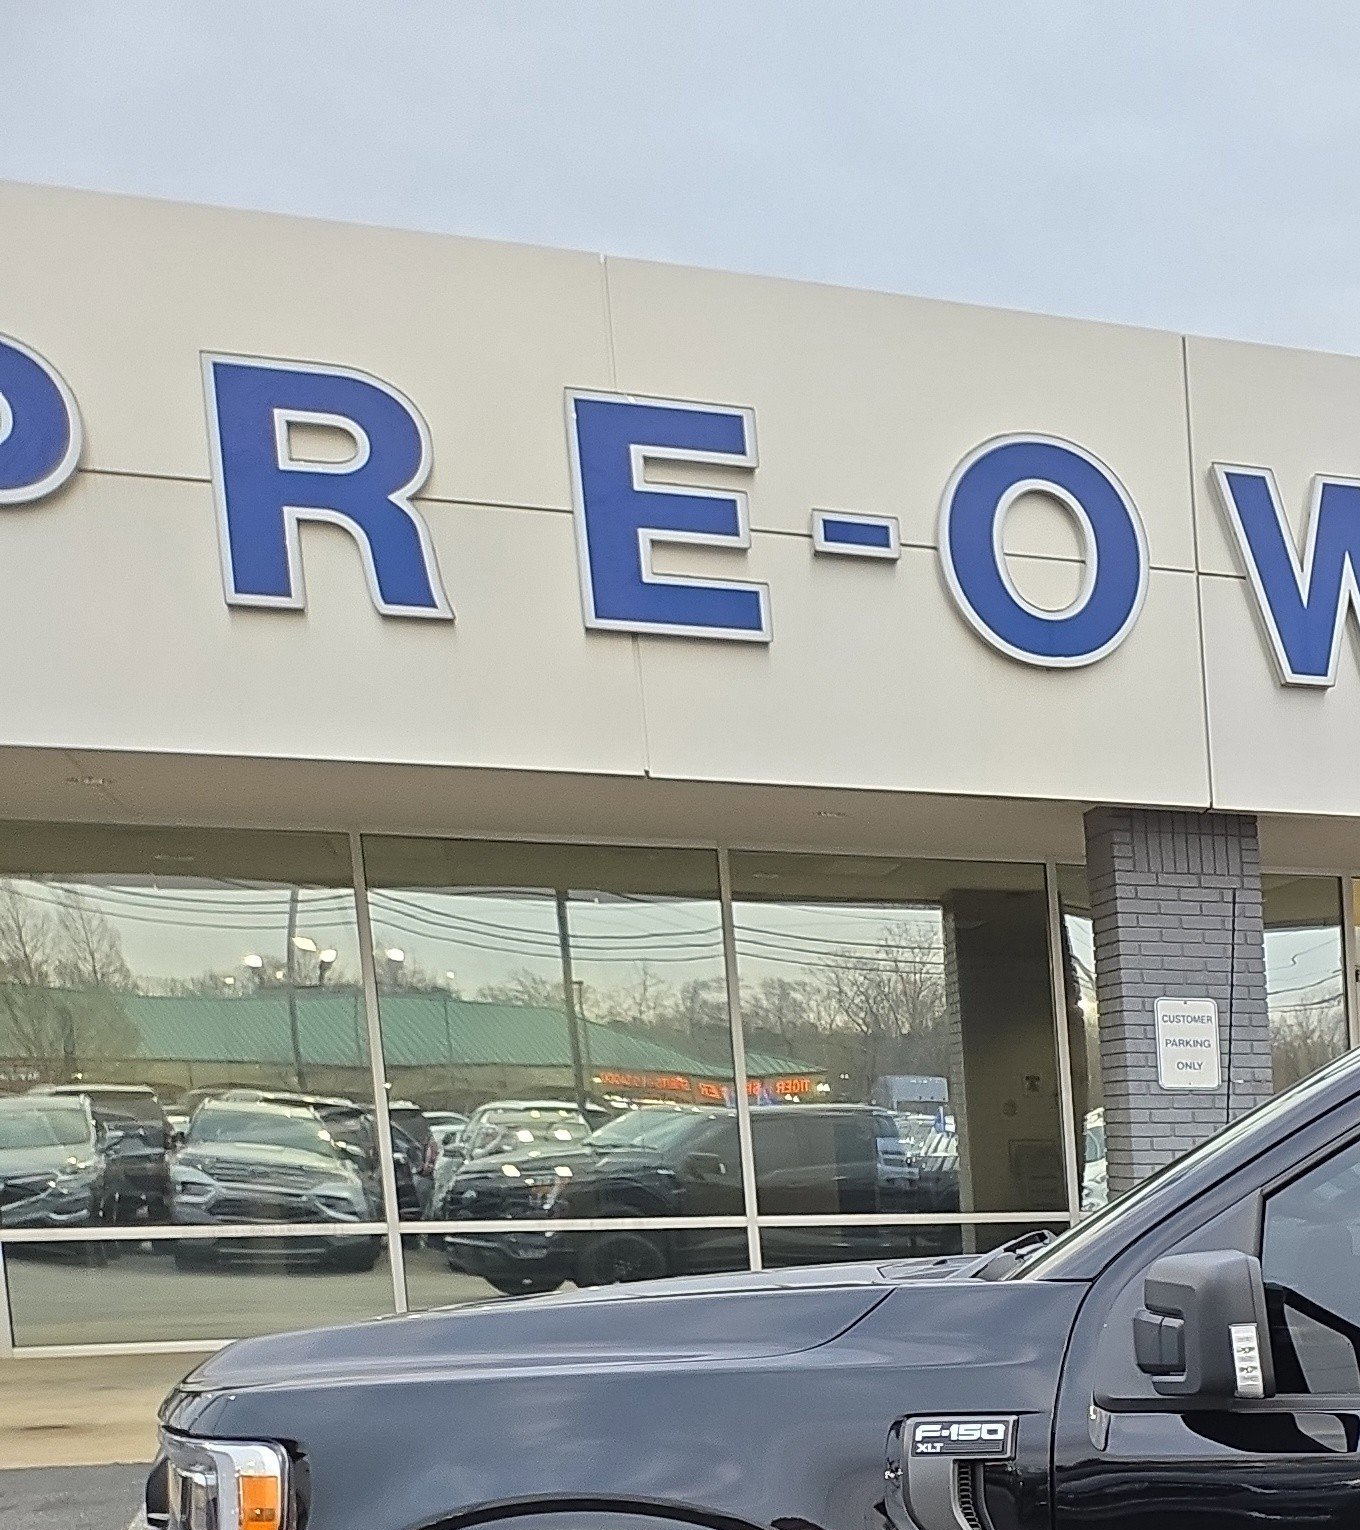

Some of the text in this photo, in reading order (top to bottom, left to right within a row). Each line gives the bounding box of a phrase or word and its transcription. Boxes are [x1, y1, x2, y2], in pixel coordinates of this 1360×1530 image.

[1162, 1014, 1213, 1024] CUSTOMER
[1165, 1038, 1211, 1049] PARKING
[1176, 1061, 1204, 1071] ONLY
[914, 1422, 1006, 1442] F-150
[914, 1442, 944, 1453] XLT
